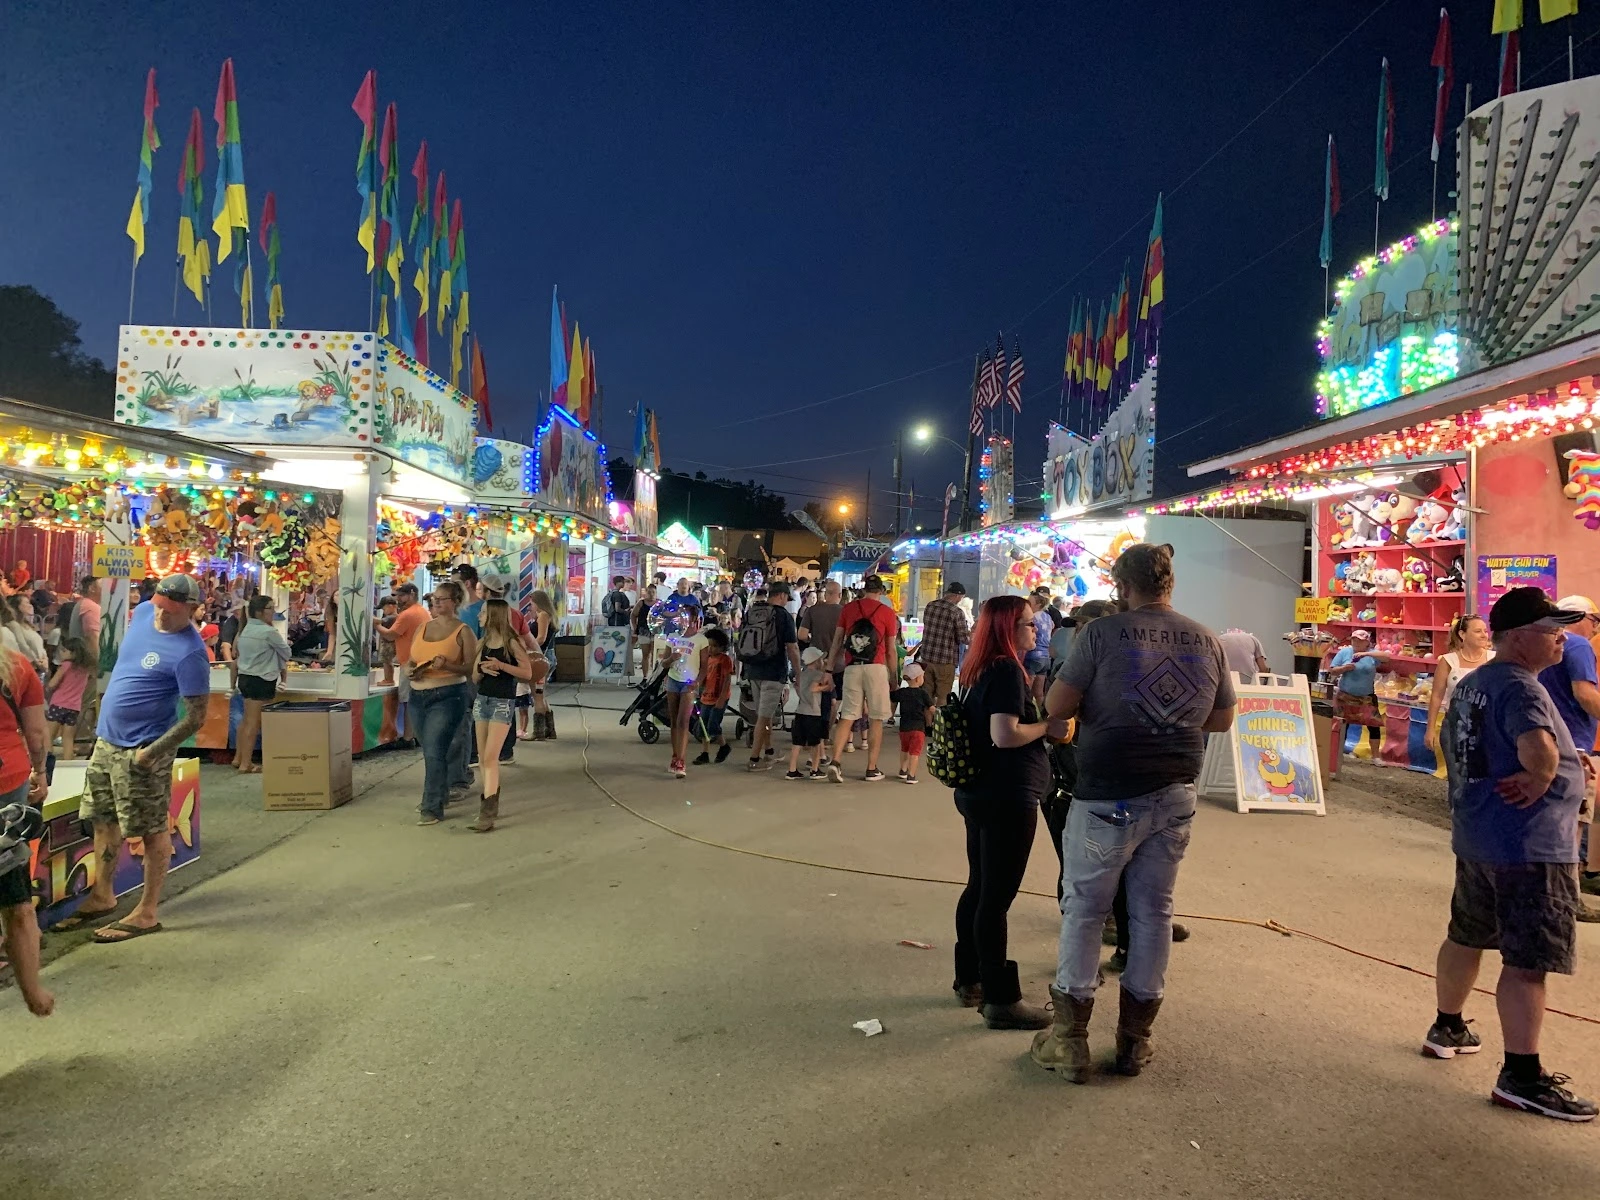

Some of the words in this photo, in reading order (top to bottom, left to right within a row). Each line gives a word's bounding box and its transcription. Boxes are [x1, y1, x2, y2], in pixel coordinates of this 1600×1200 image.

[1053, 450, 1089, 508] TOY
[1092, 433, 1136, 499] BOX
[107, 547, 134, 557] KIDS
[97, 557, 143, 568] ALWAYS
[1486, 558, 1513, 568] WATER
[1514, 558, 1531, 567] GUN
[1533, 558, 1549, 567] FUN
[108, 567, 130, 577] WIN
[1303, 599, 1320, 607] KIDS
[1119, 628, 1214, 650] AMERICAN
[1247, 718, 1297, 732] WINNER
[1240, 734, 1307, 750] EVERYTIME
